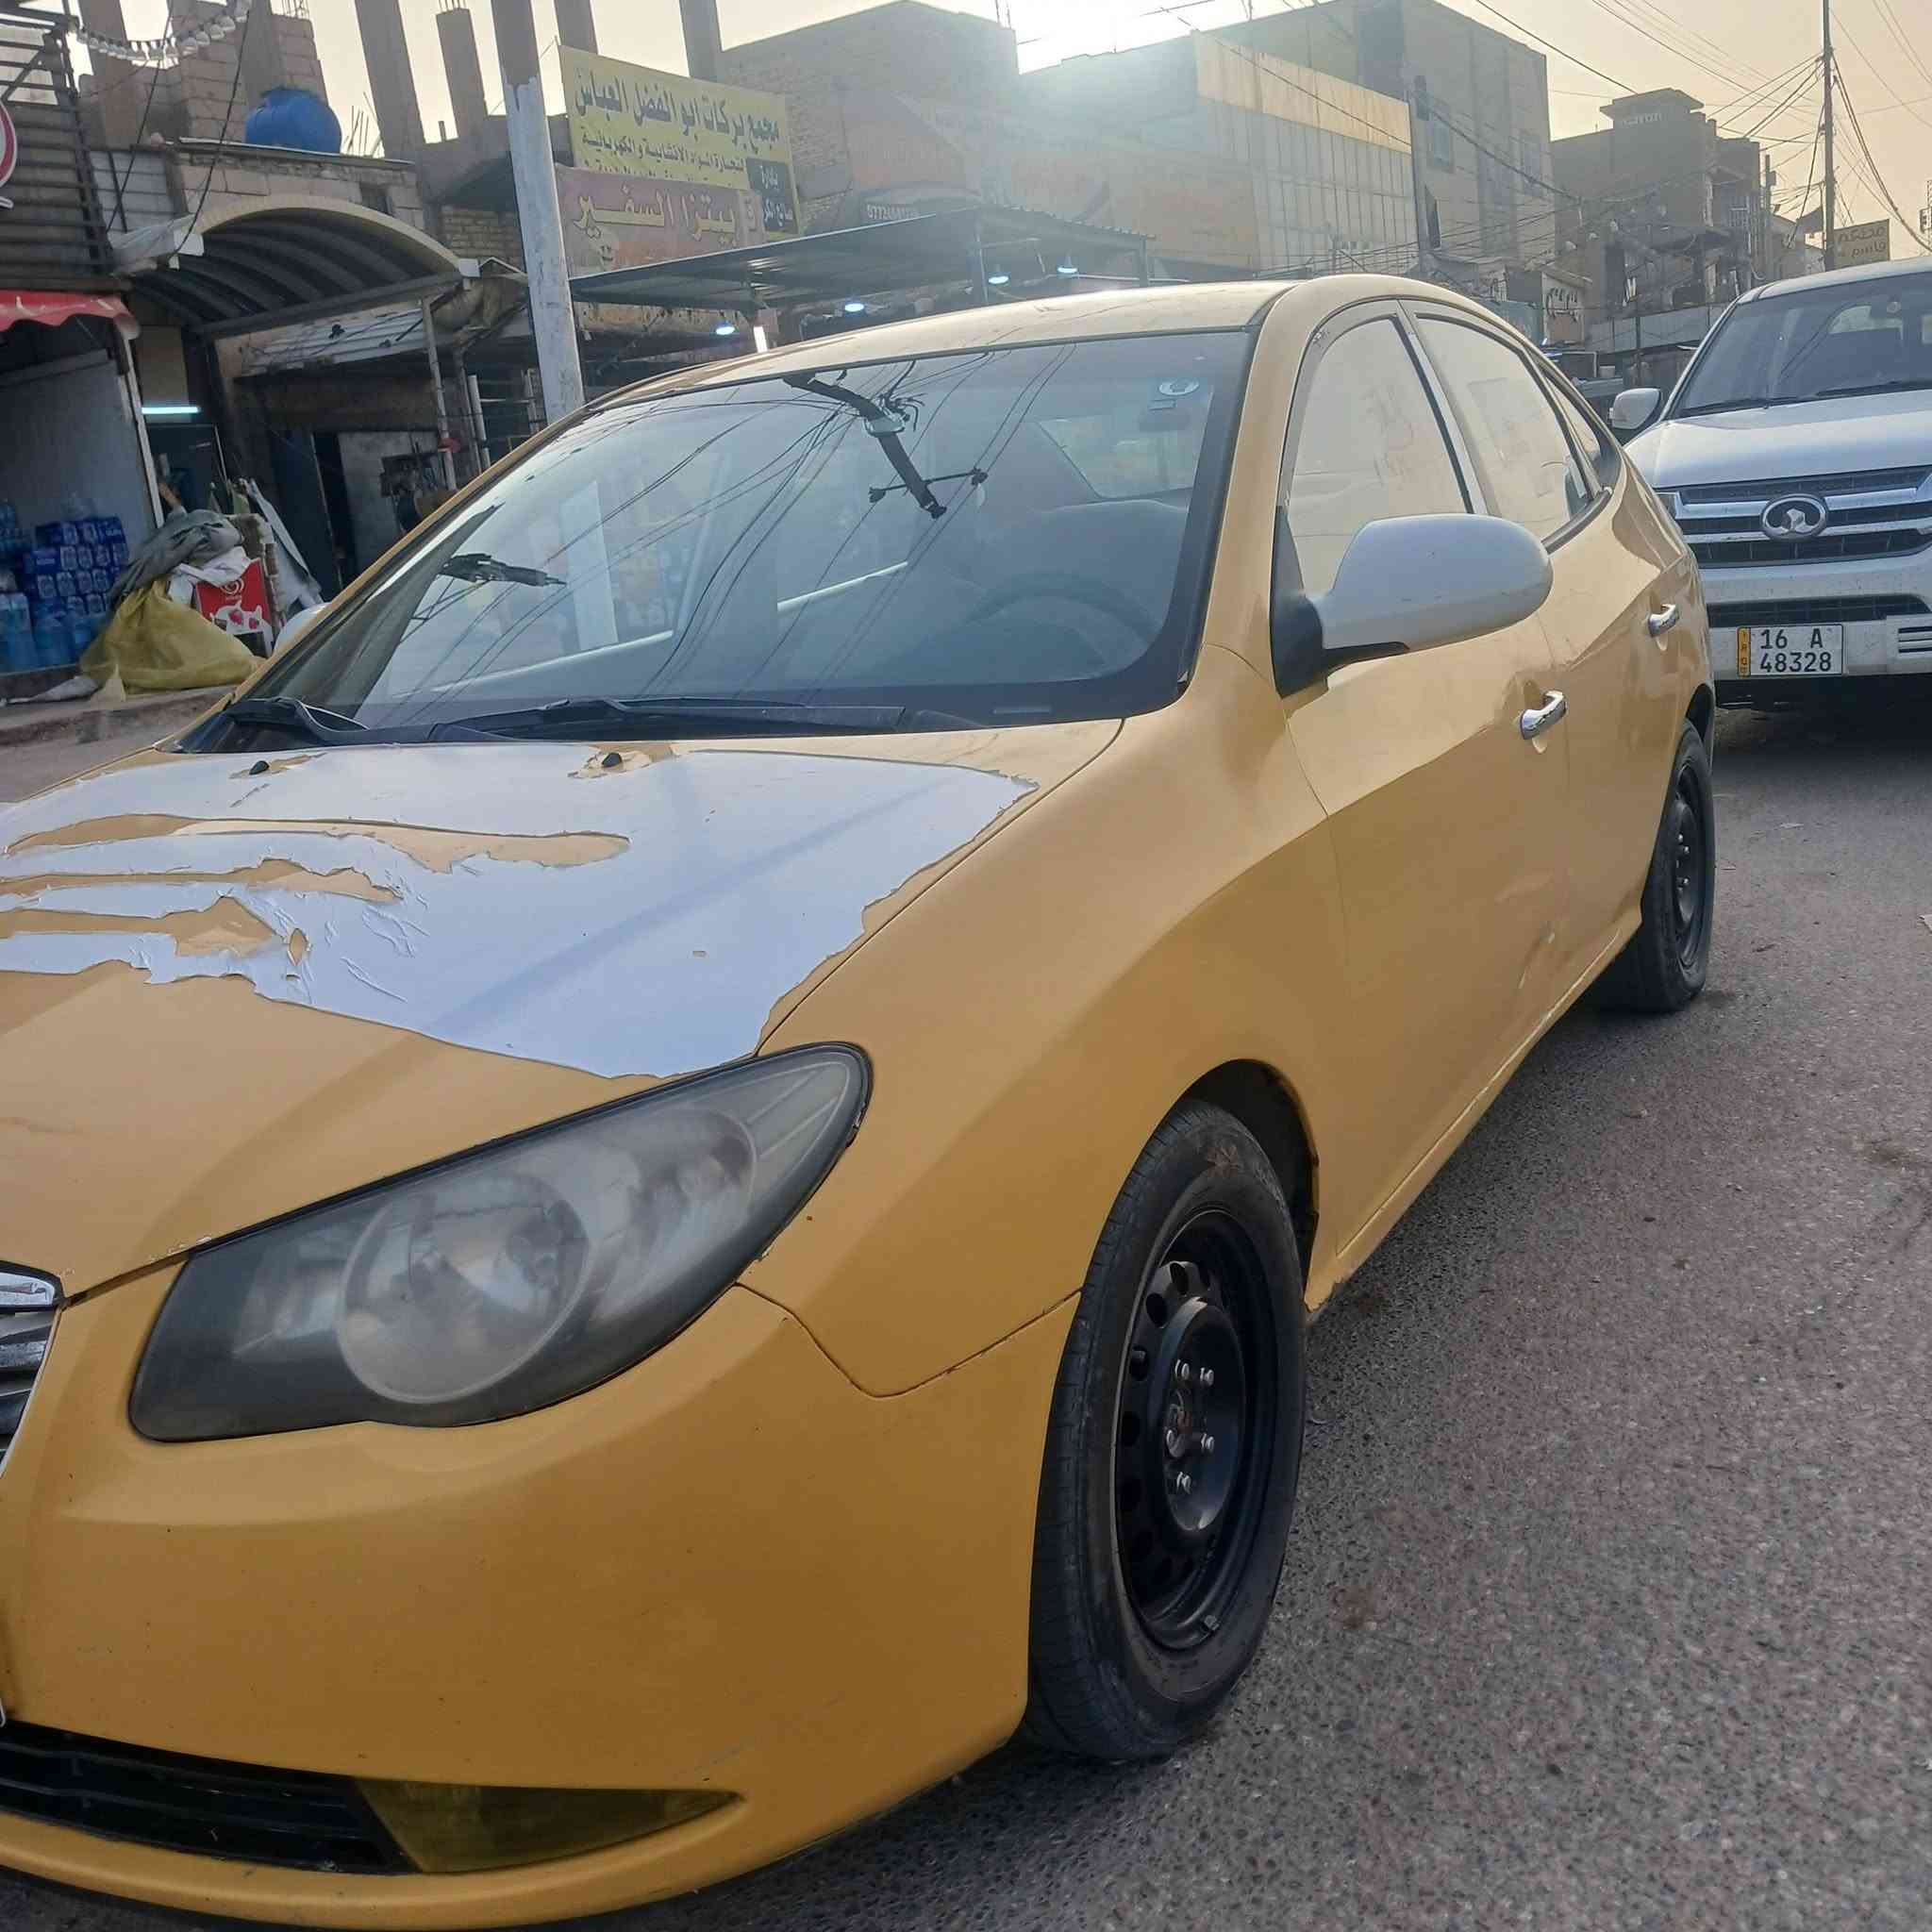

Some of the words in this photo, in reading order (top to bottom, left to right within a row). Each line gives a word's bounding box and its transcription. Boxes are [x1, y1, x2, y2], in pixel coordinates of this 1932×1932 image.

[633, 82, 678, 126] الفضل
[1760, 629, 1788, 649] 16
[1810, 628, 1823, 648] A
[1760, 652, 1831, 673] 48328
